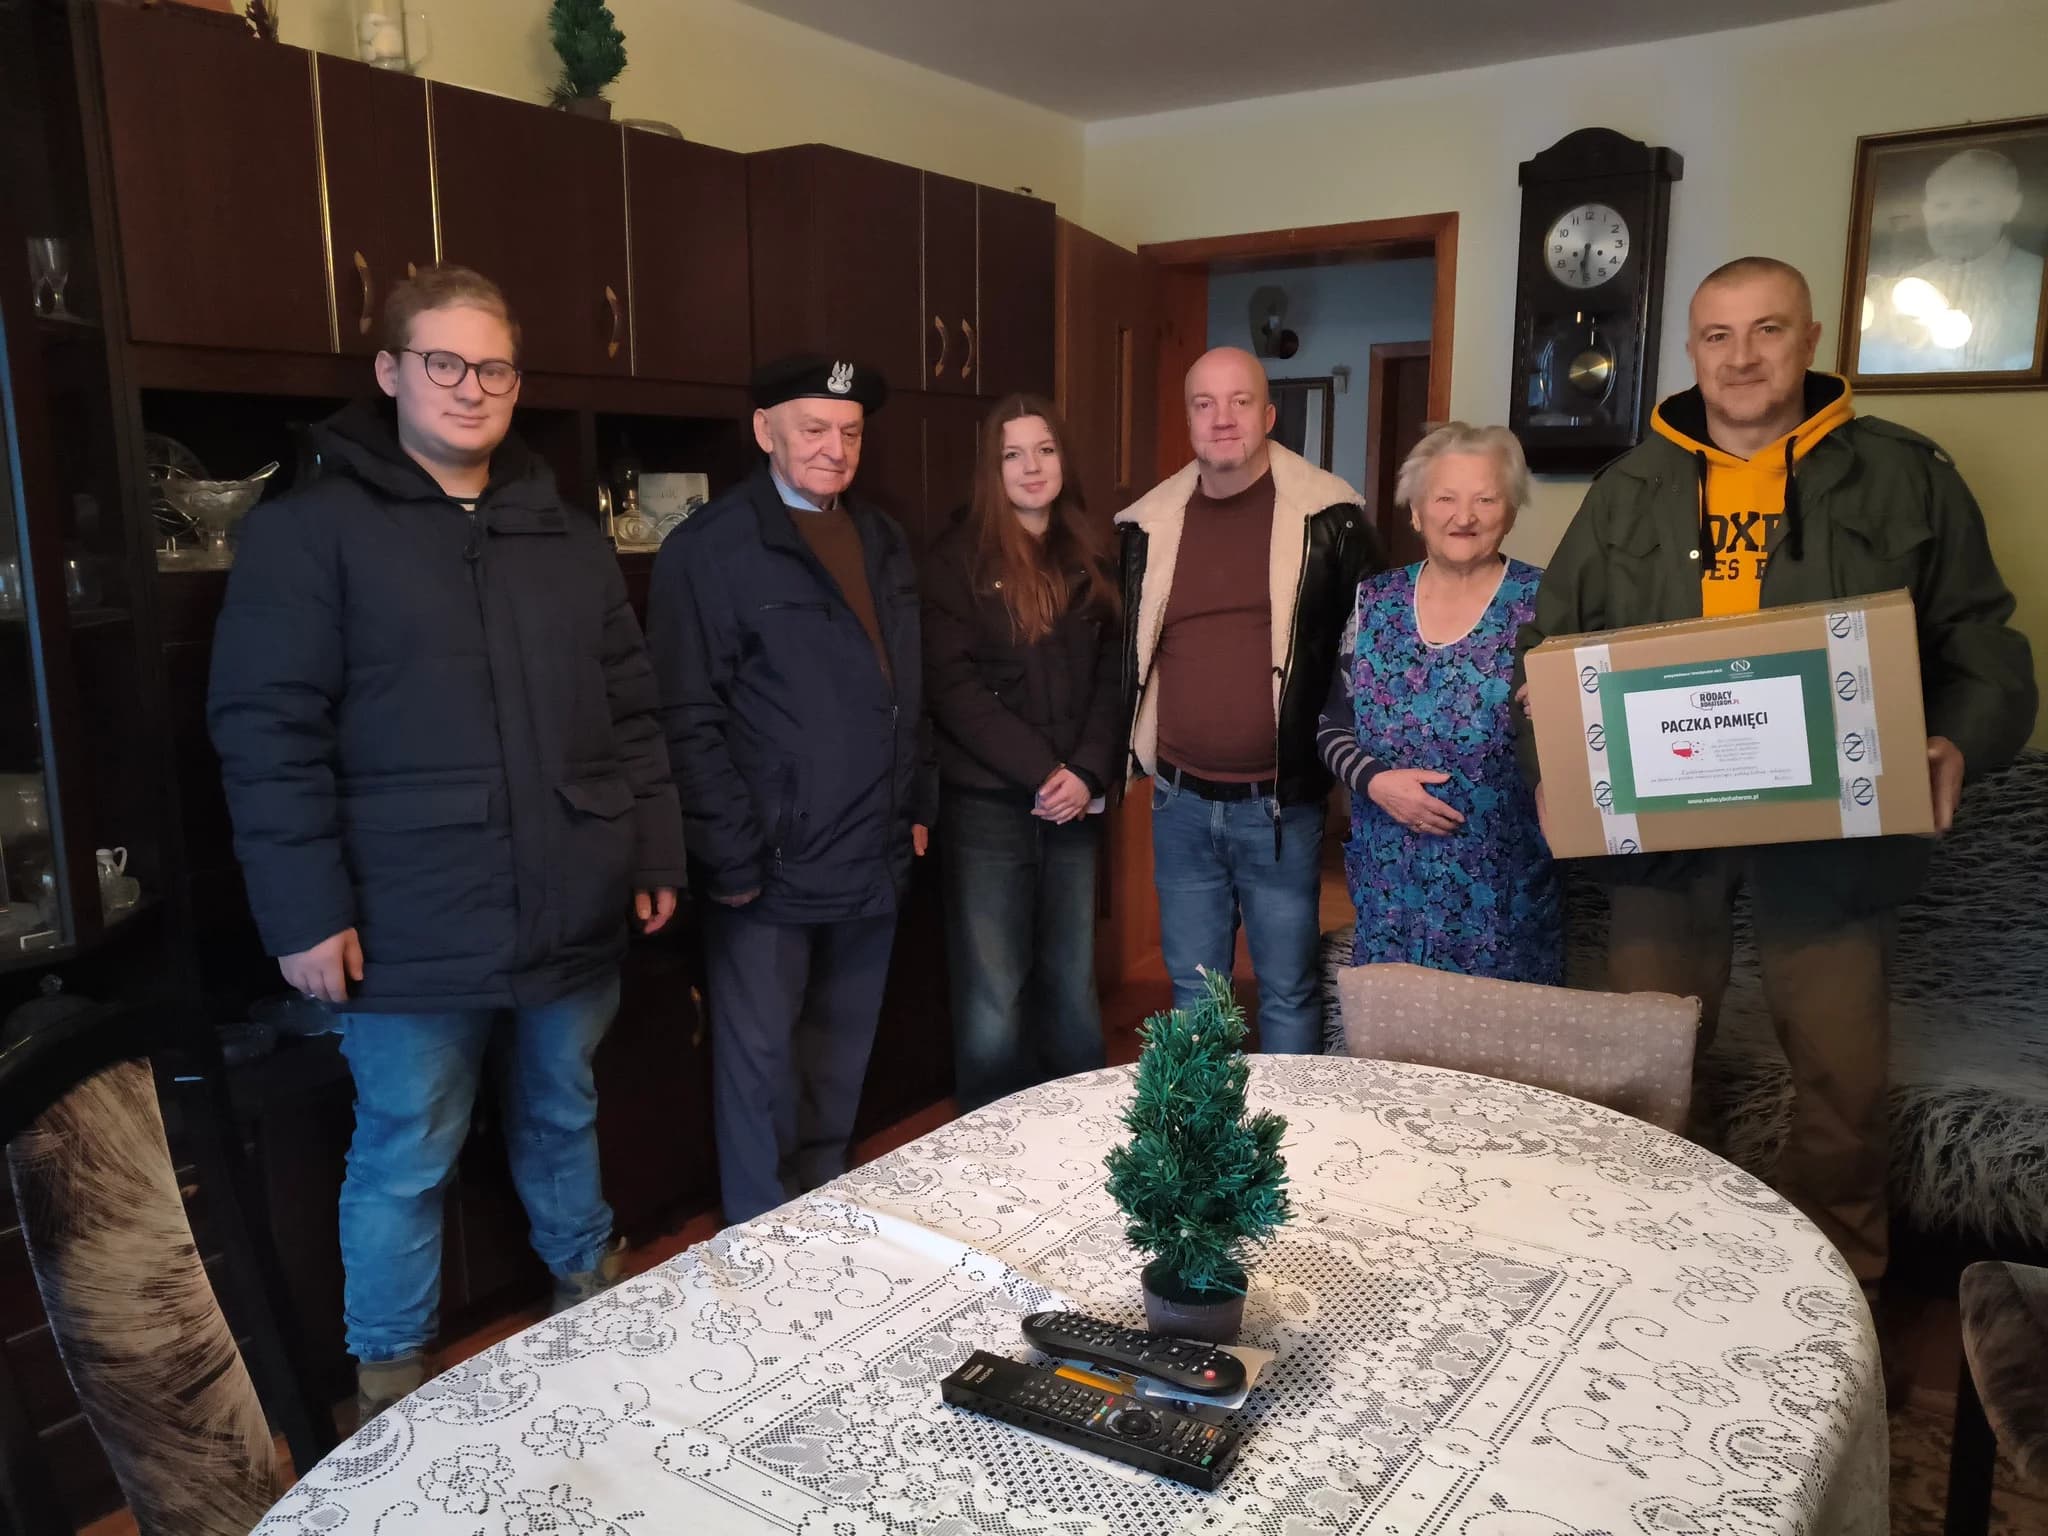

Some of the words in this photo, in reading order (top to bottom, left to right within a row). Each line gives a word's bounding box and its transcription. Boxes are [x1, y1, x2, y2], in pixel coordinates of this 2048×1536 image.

[1572, 215, 1580, 225] 11
[1585, 211, 1594, 221] 12
[1559, 228, 1569, 238] 10
[1610, 224, 1620, 234] 2
[1554, 244, 1563, 254] 9
[1614, 239, 1624, 249] 3
[1556, 259, 1566, 269] 8
[1609, 255, 1618, 265] 4
[1567, 269, 1577, 279] 7
[1597, 267, 1607, 277] 5
[1699, 690, 1732, 702] RODACY
[1661, 717, 1711, 734] PACZKA
[1714, 711, 1769, 730] PAMIĘCI
